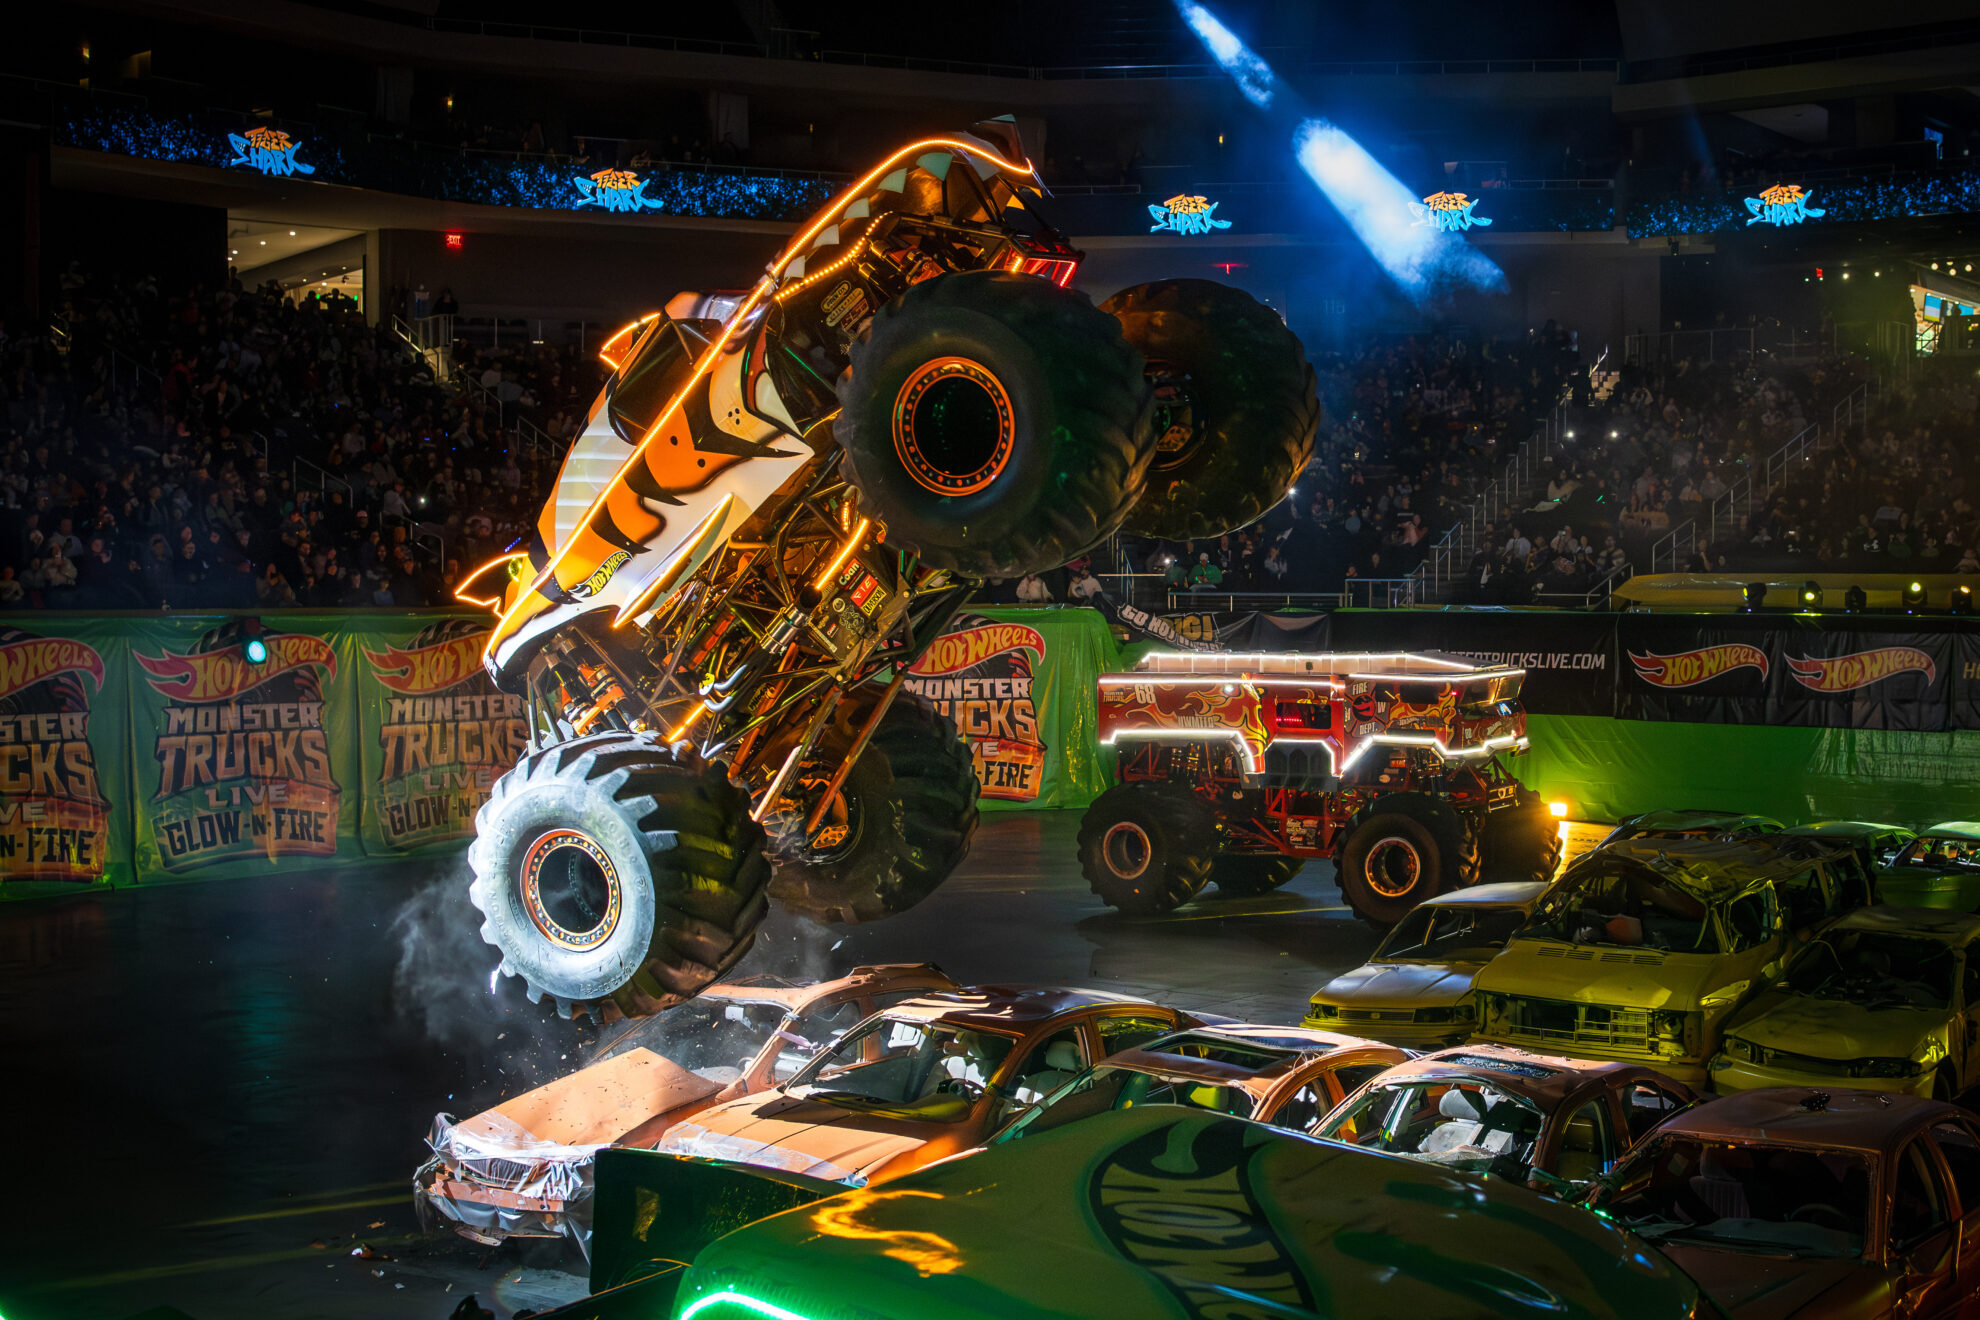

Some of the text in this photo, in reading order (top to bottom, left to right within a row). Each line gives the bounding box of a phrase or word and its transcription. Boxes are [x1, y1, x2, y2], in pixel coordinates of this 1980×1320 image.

[244, 126, 293, 151] TIGER
[227, 133, 316, 177] SHARK
[590, 168, 641, 190] TIGER
[573, 177, 664, 212] SHARK
[1163, 194, 1211, 215] TIGER
[1744, 189, 1826, 227] SHARK
[1759, 184, 1805, 205] TIGER
[1148, 202, 1232, 235] SHARK
[1160, 615, 1213, 641] IG!
[920, 638, 967, 673] HOT
[406, 651, 458, 690] HOT
[1660, 656, 1702, 685] HOT
[1819, 659, 1861, 689] HOT
[903, 677, 1033, 700] MONSTER
[1135, 683, 1157, 704] 68
[1352, 681, 1368, 695] FIRE
[163, 702, 323, 734] MONSTER
[387, 694, 524, 724] MONSTER
[934, 699, 1042, 748] UCKS
[155, 729, 341, 800] TRUCKS
[422, 769, 493, 790] LIVE
[204, 783, 289, 808] LIVE
